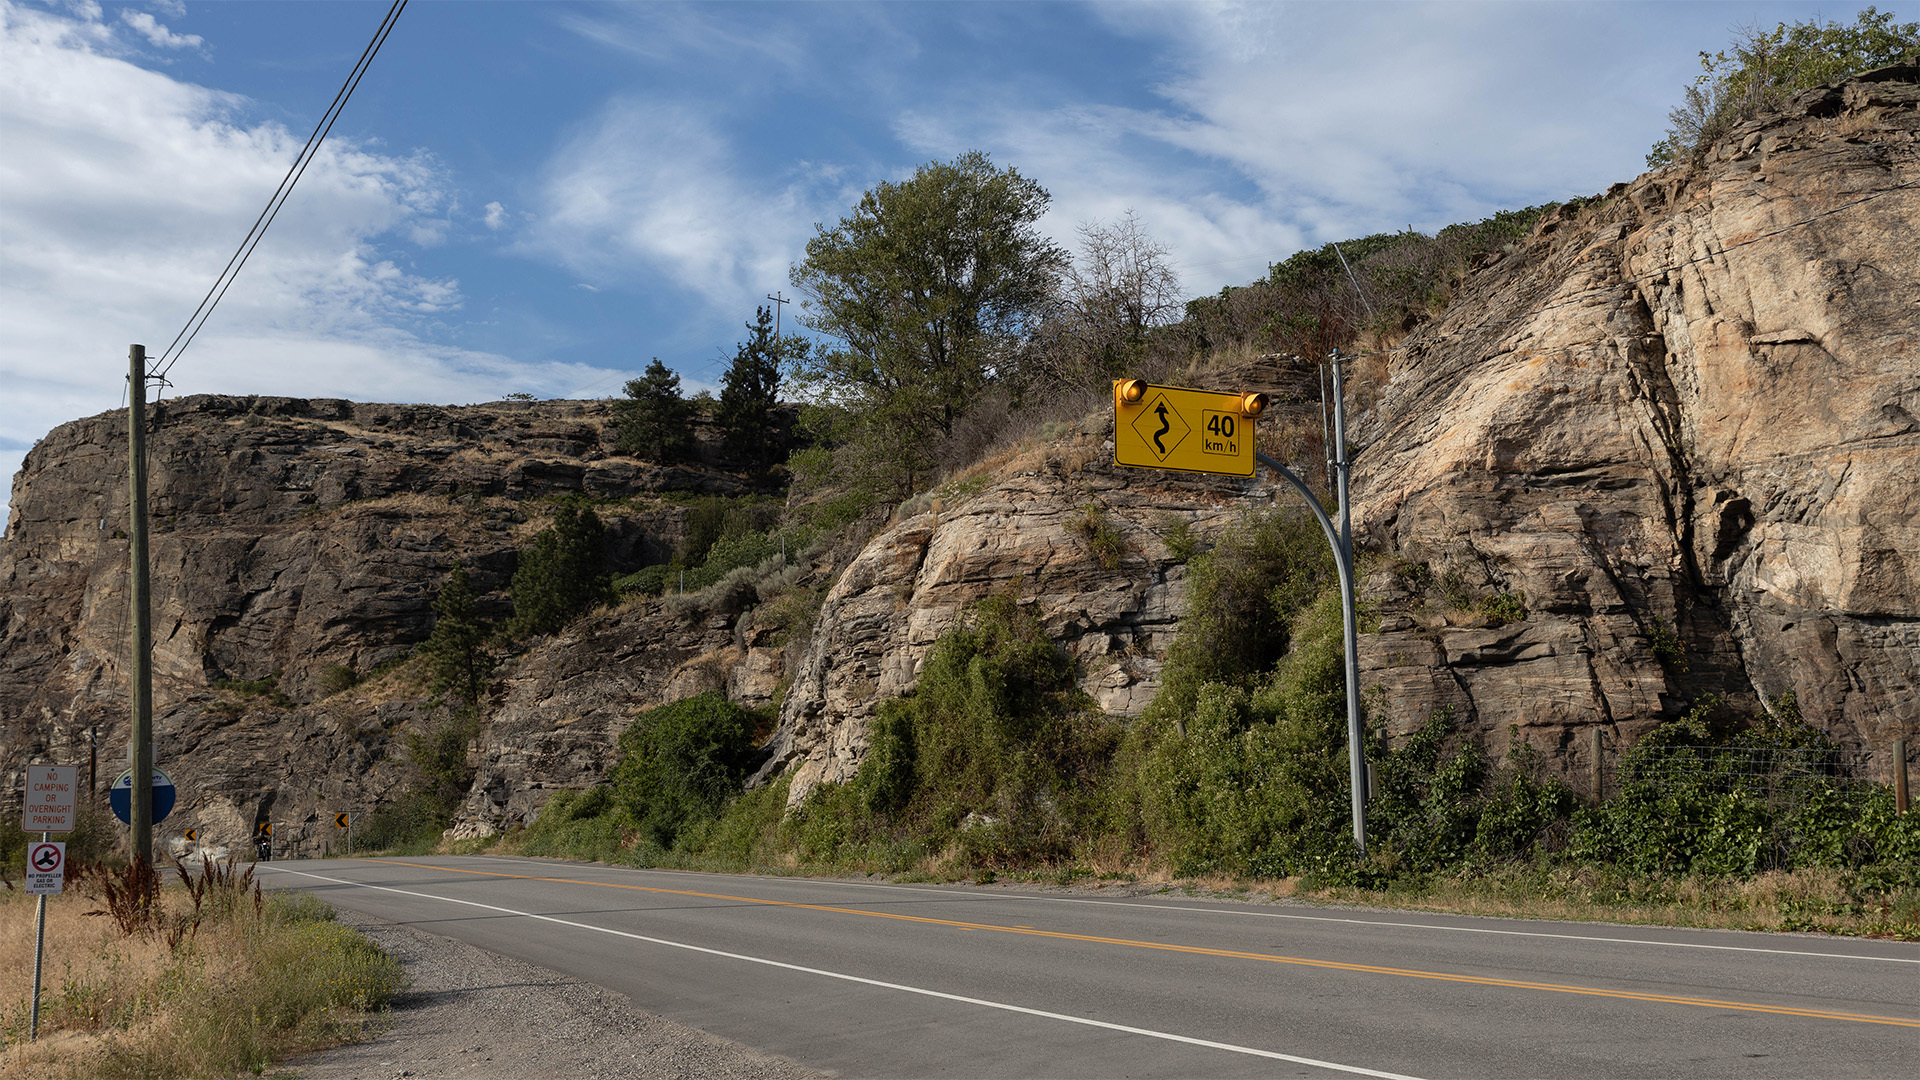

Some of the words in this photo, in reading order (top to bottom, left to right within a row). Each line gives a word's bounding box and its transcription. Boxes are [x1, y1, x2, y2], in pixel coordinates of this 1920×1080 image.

[1207, 415, 1234, 437] 40
[1205, 439, 1236, 452] km/h
[47, 773, 58, 781] NO
[34, 783, 69, 792] CAMPING
[45, 794, 57, 802] OR
[29, 805, 72, 813] OVERNIGHT
[33, 816, 66, 824] PARKING
